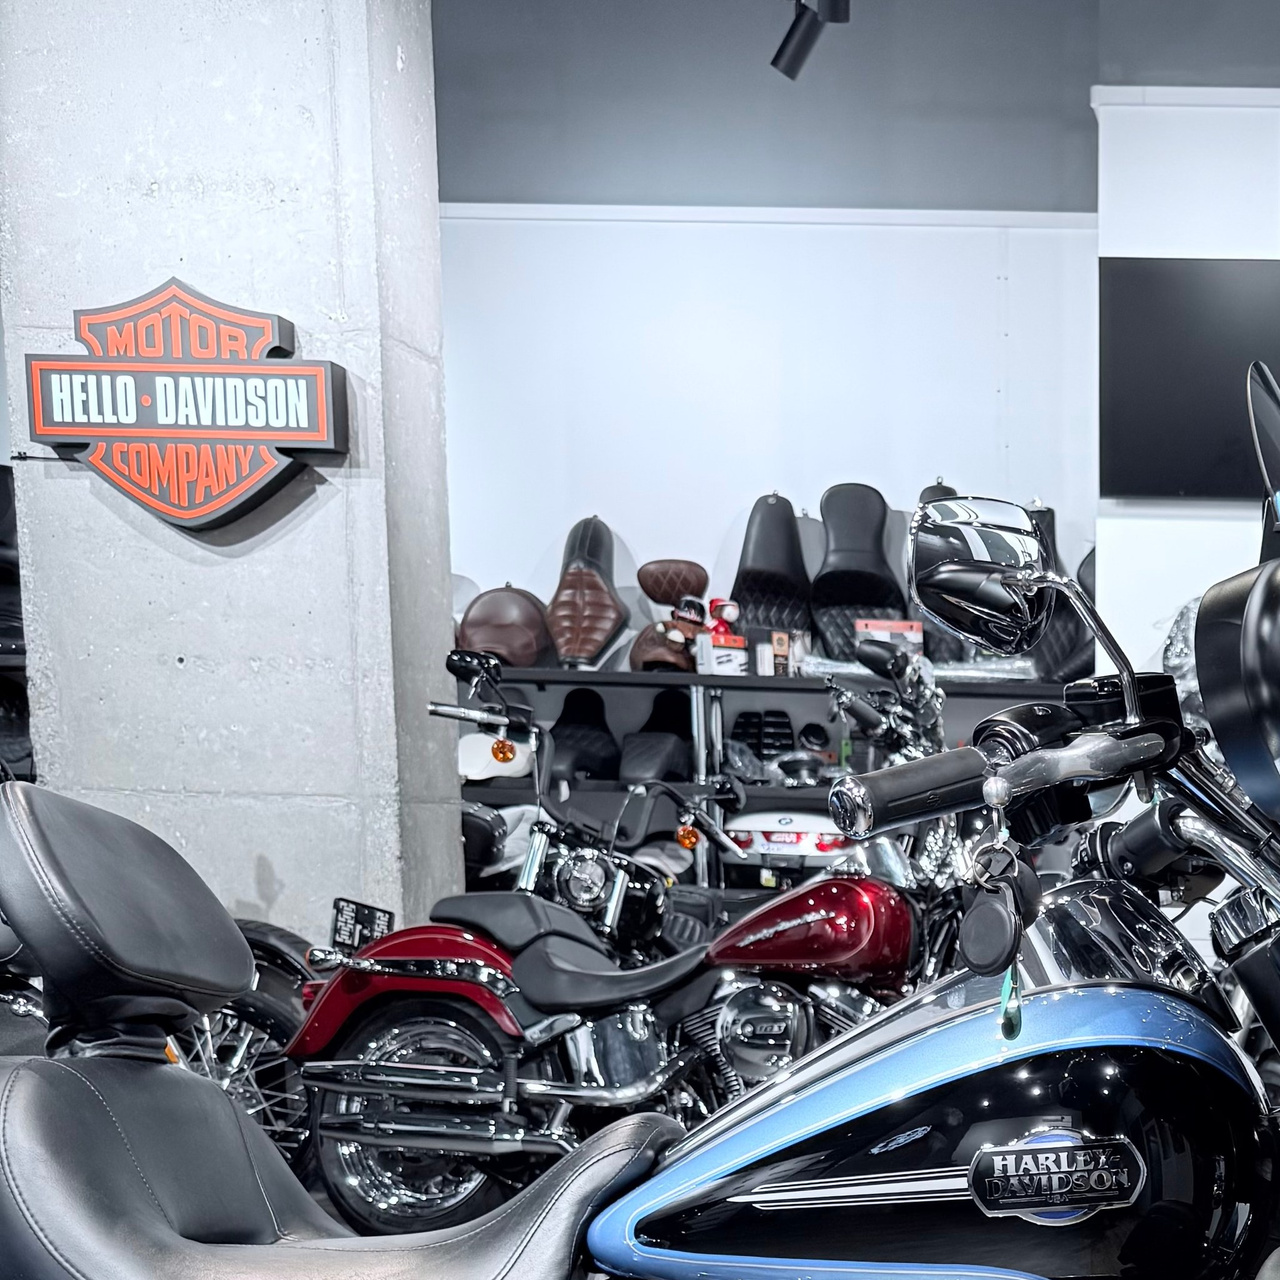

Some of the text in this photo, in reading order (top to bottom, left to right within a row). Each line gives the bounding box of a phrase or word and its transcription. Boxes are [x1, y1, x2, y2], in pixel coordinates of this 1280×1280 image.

[107, 302, 248, 360] MOTOR
[51, 374, 309, 428] HELLO DAVIDSON
[111, 442, 254, 507] COMPANY
[984, 1168, 1131, 1200] DAVIDSON
